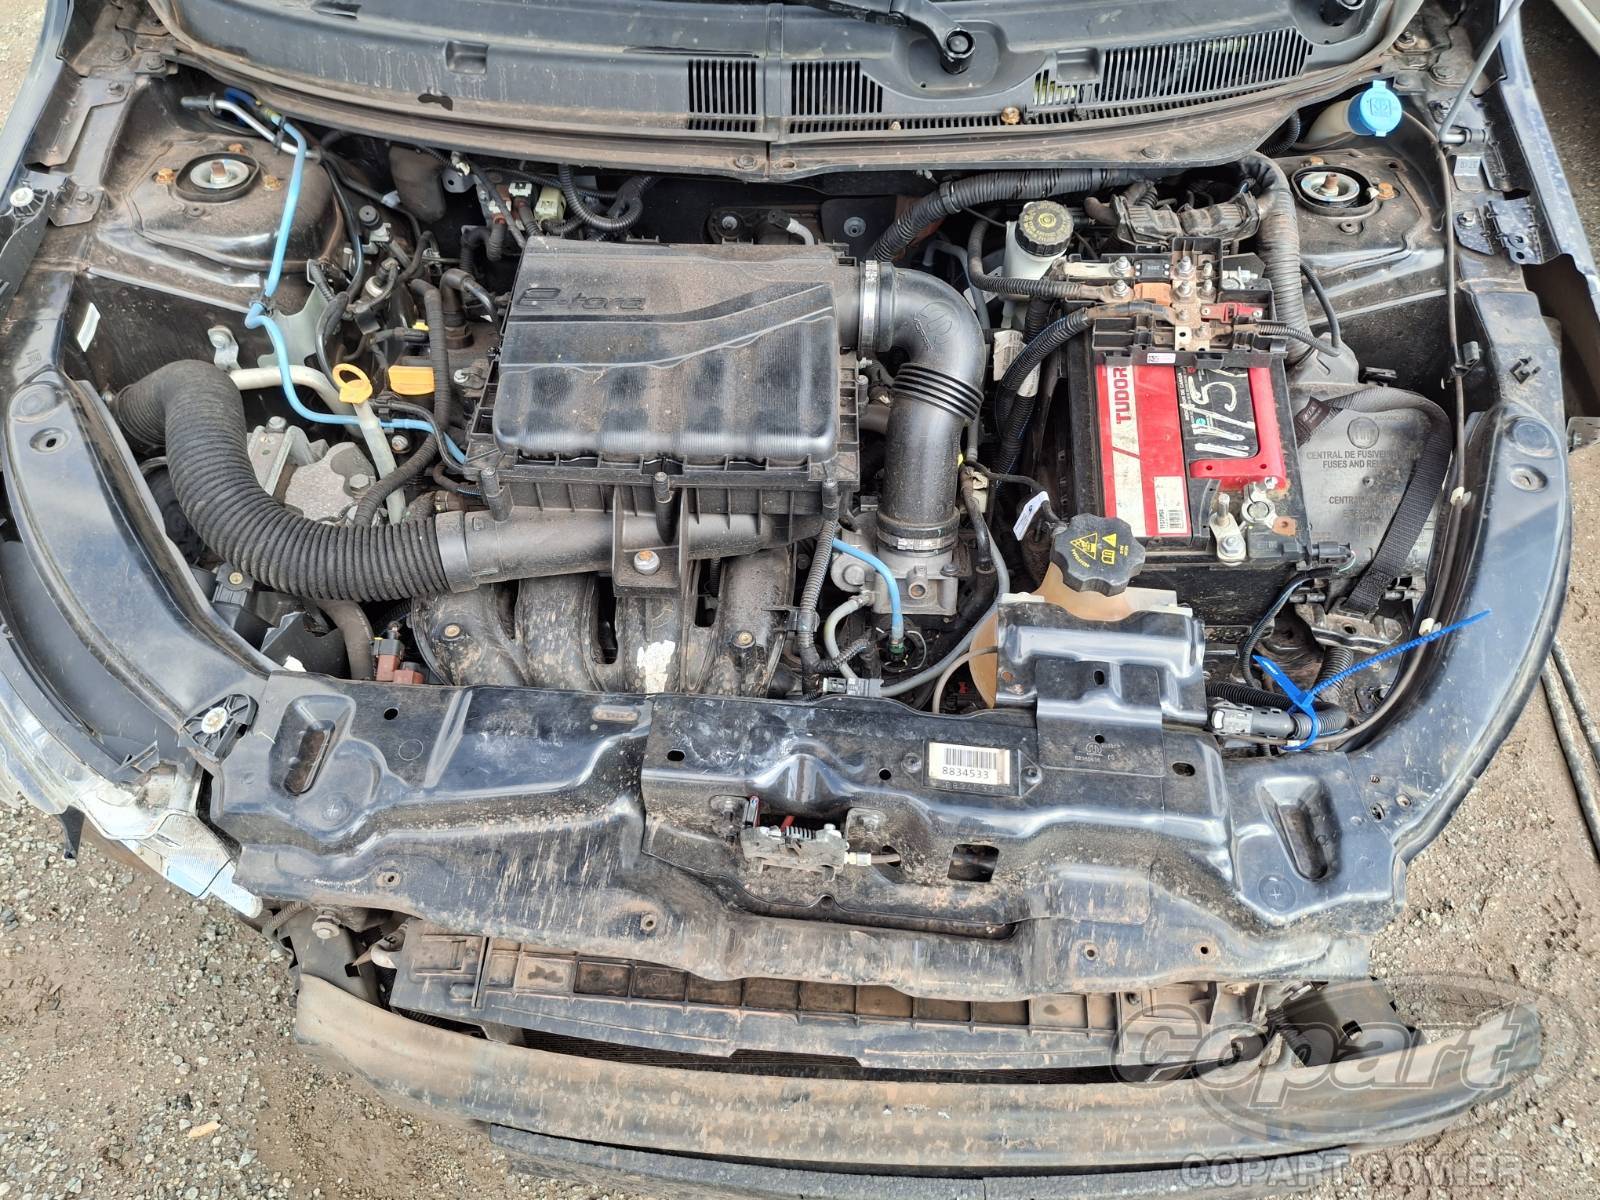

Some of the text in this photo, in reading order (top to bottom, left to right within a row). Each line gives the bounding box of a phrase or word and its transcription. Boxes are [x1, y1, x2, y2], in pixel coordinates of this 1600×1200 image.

[1113, 367, 1131, 424] TUDOR
[1306, 449, 1343, 460] CENTRAL
[1344, 449, 1356, 459] DE
[1322, 460, 1347, 469] FUSES
[1348, 460, 1365, 469] AND
[942, 766, 989, 779] 8834533
